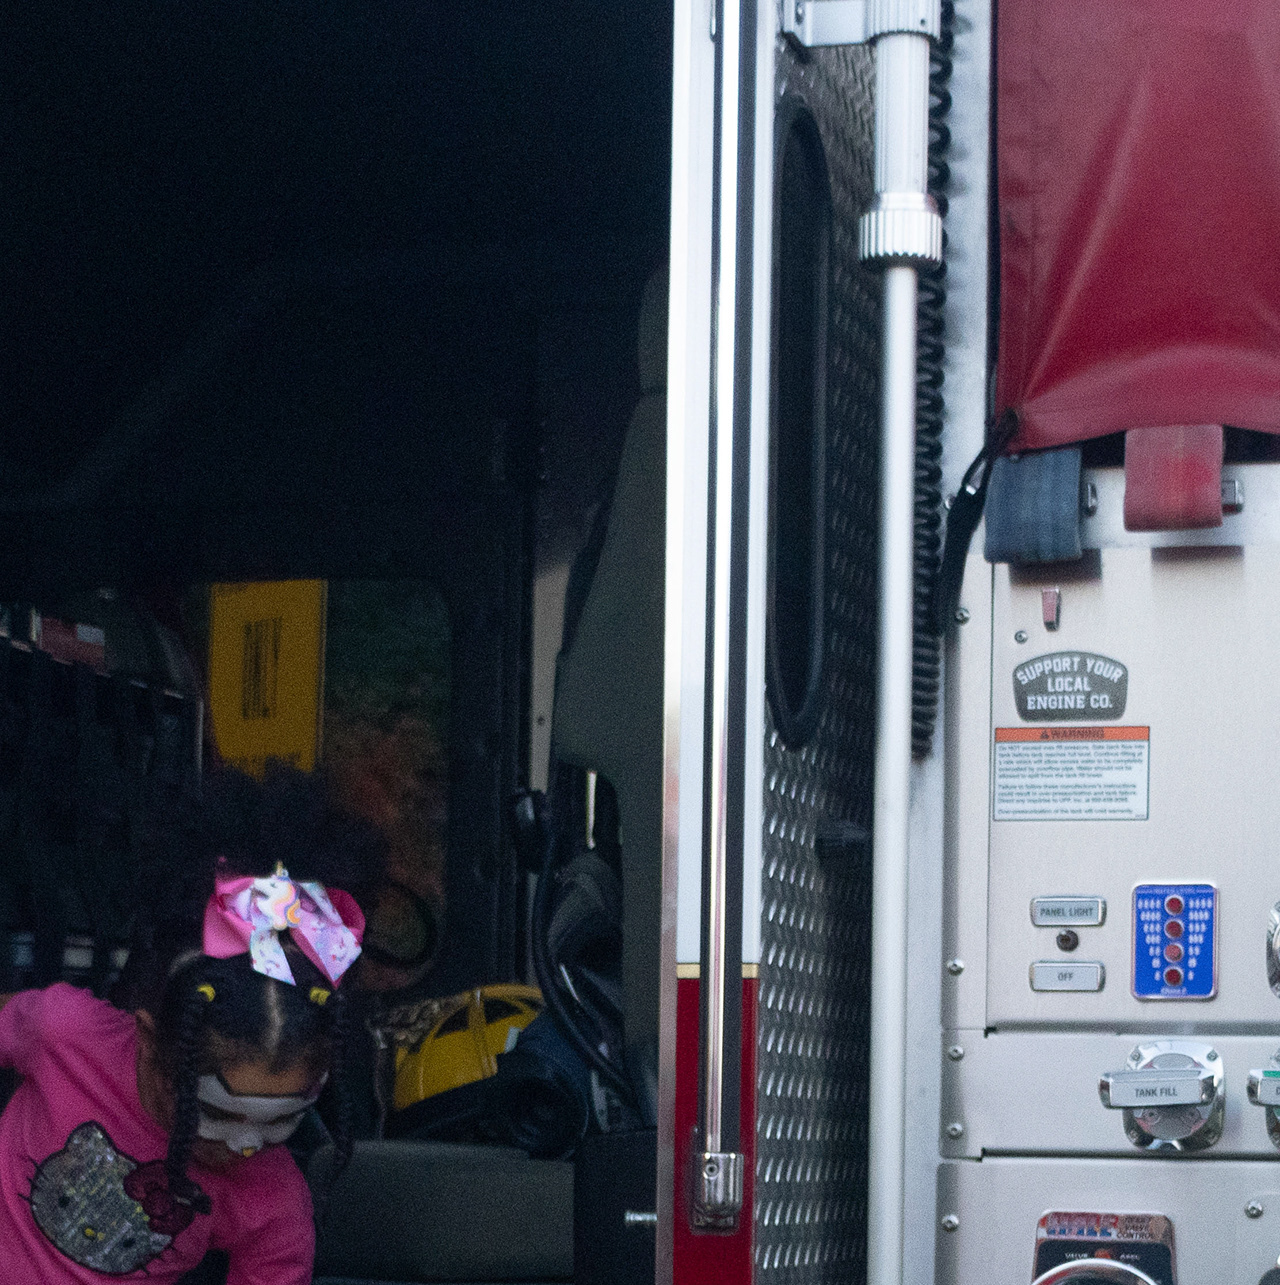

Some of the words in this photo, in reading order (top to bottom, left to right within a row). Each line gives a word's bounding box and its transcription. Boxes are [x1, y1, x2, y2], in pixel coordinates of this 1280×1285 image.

[1016, 656, 1081, 685] SUPPORT
[1086, 658, 1124, 684] YOUR
[1047, 676, 1091, 693] LOCAL
[1026, 695, 1086, 710] ENGINE
[1090, 694, 1113, 709] CO.
[1040, 907, 1066, 917] PANEL
[1070, 907, 1093, 917] LIGHT
[1057, 973, 1074, 981] OFF
[1134, 1087, 1158, 1098] TANK
[1160, 1087, 1178, 1097] FILL
